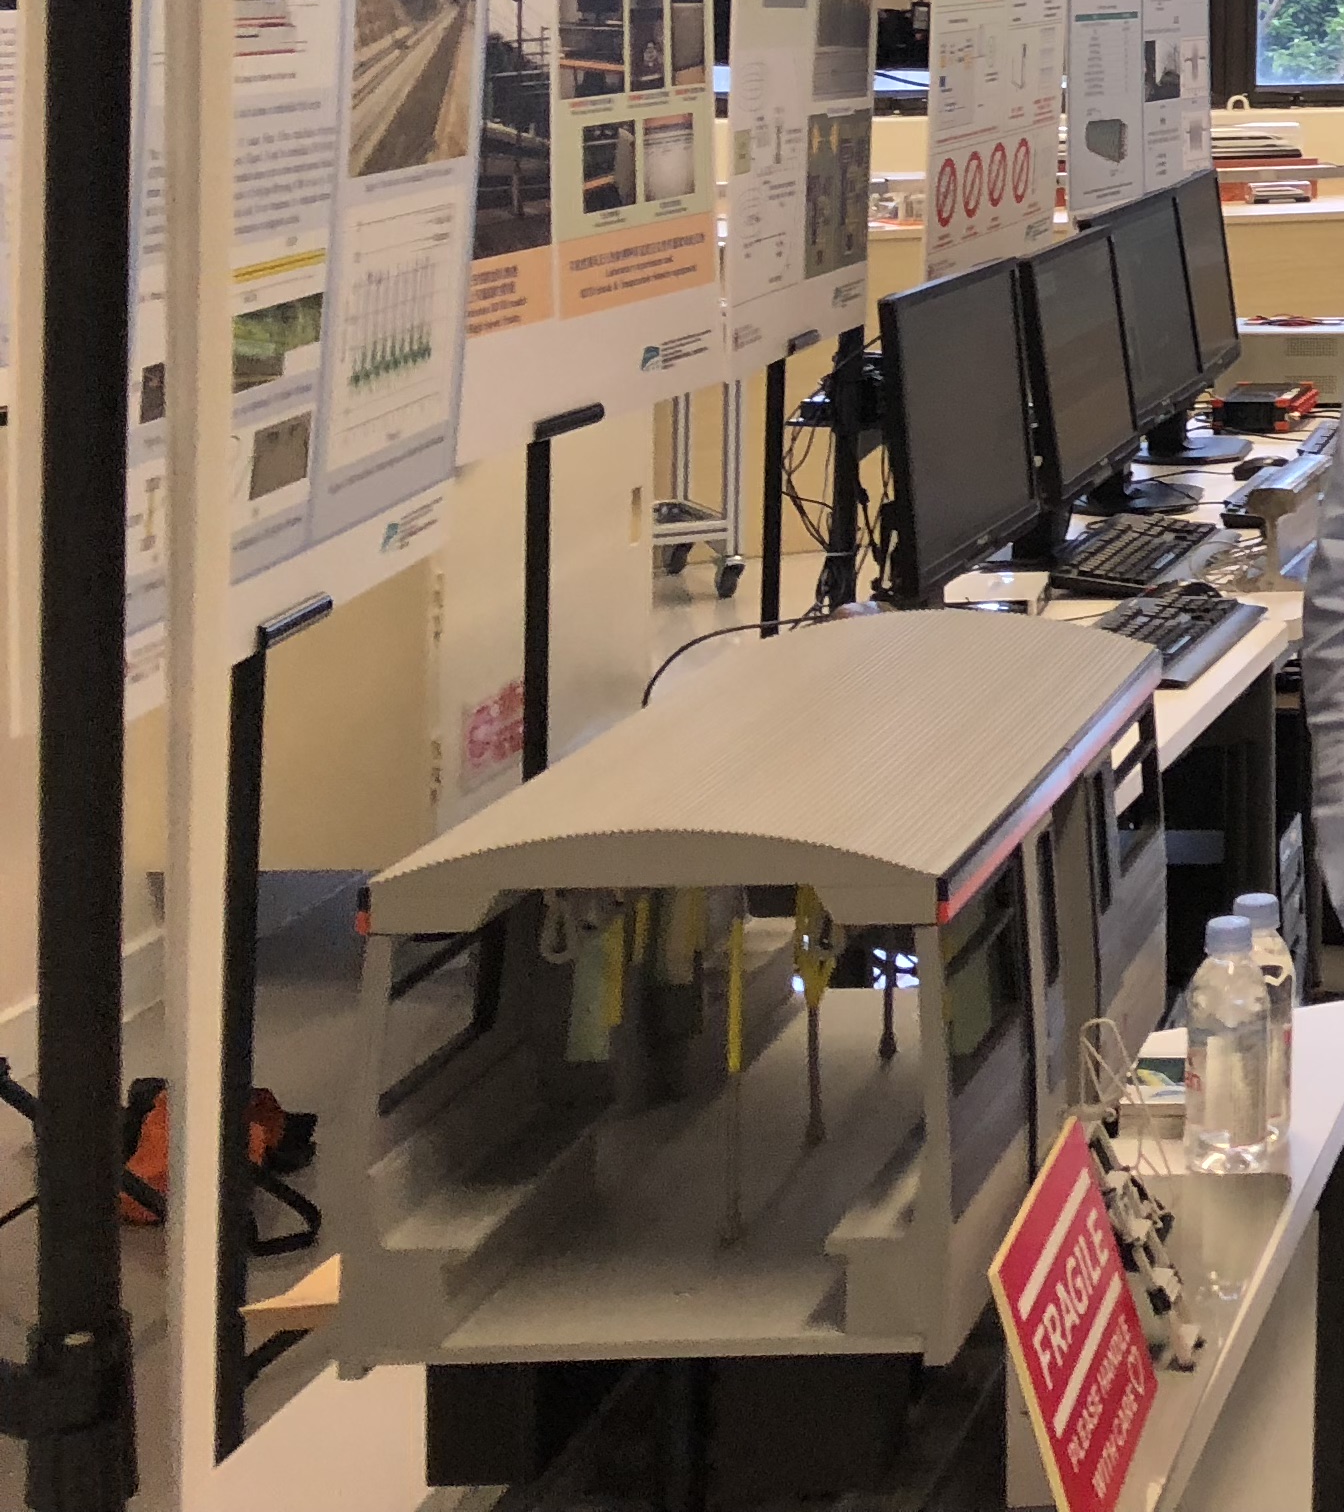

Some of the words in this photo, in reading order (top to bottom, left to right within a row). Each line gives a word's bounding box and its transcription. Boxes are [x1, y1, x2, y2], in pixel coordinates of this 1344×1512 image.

[1033, 1207, 1109, 1391] FRAGILE
[1067, 1382, 1103, 1473] PLEASE
[1097, 1313, 1131, 1399] HANDLE
[1091, 1436, 1122, 1500] WITH
[1112, 1380, 1139, 1447] CARE
